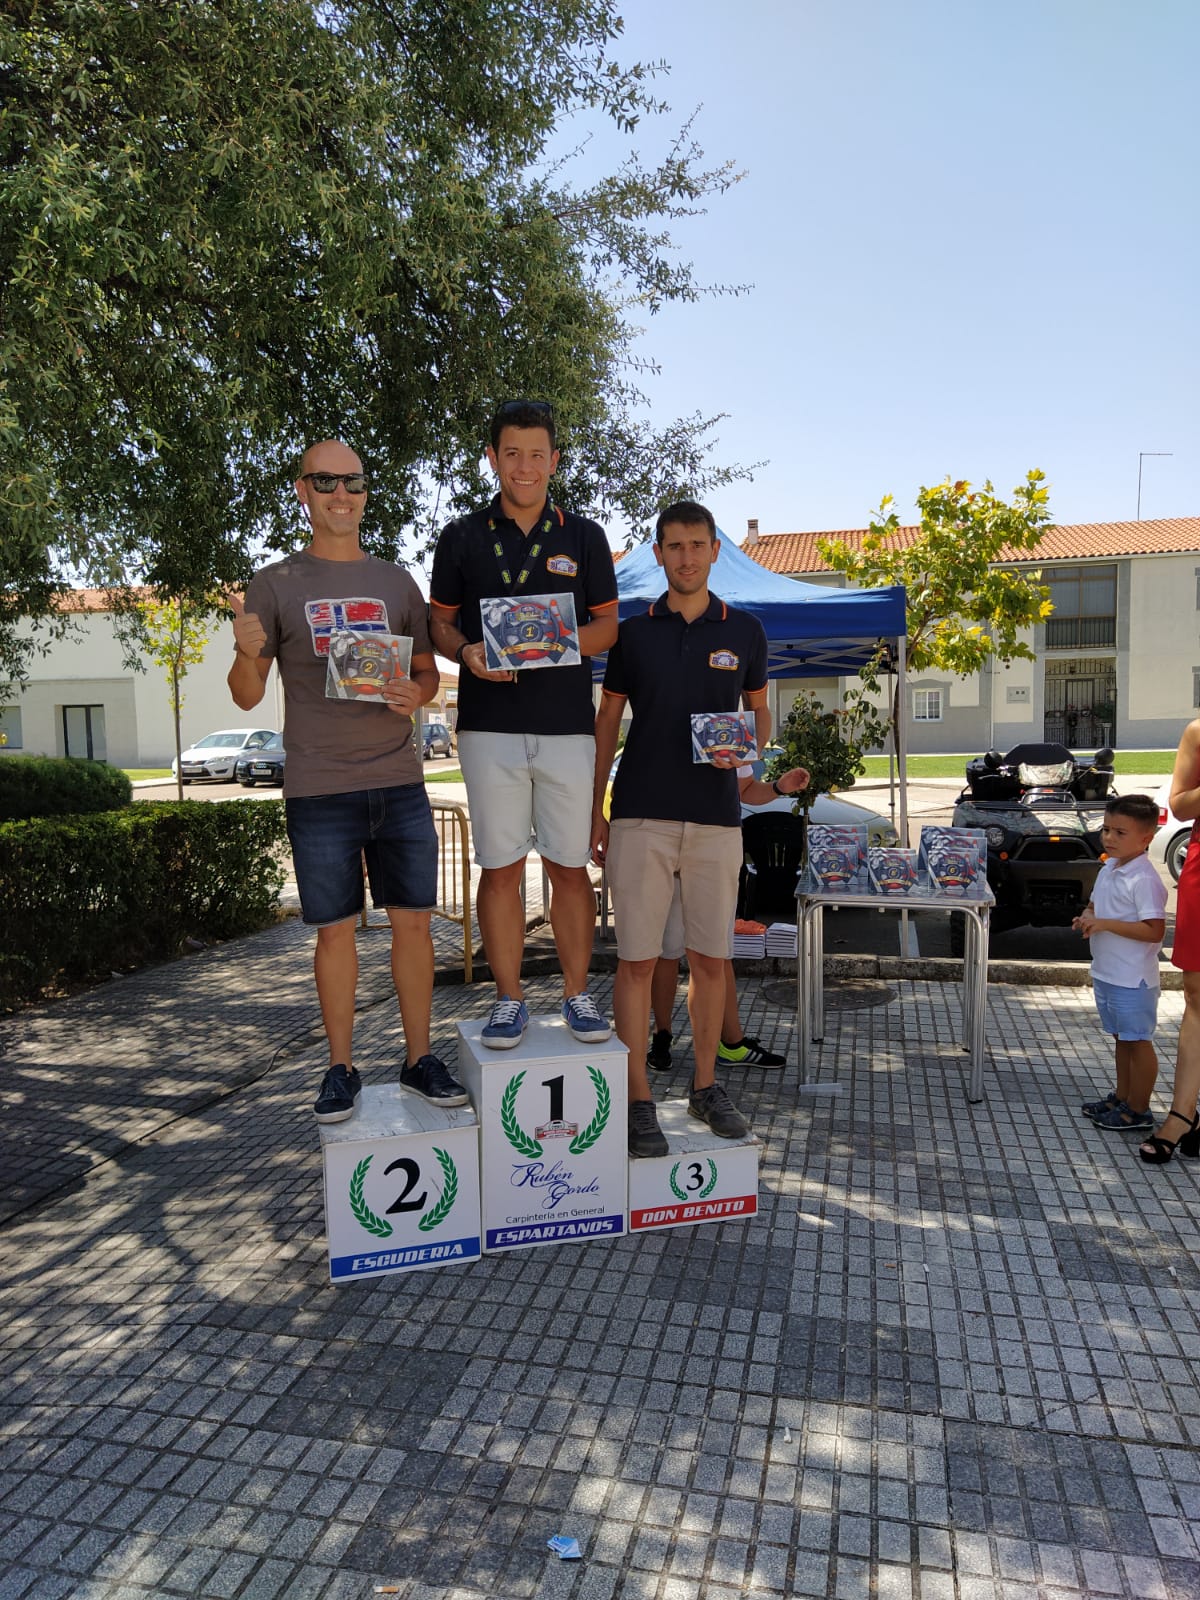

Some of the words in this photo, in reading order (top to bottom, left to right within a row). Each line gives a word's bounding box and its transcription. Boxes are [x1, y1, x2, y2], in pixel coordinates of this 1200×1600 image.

[541, 1074, 564, 1121] 1
[383, 1157, 428, 1214] 2
[510, 1160, 574, 1188] Rubén
[686, 1162, 705, 1191] 3
[541, 1176, 600, 1210] Gordo
[557, 1210, 569, 1218] en
[570, 1205, 605, 1217] General
[641, 1209, 678, 1224] DON
[682, 1200, 745, 1219] BENITO
[495, 1220, 614, 1244] ESPARTANOS
[351, 1243, 464, 1271] ESCUDERIA
